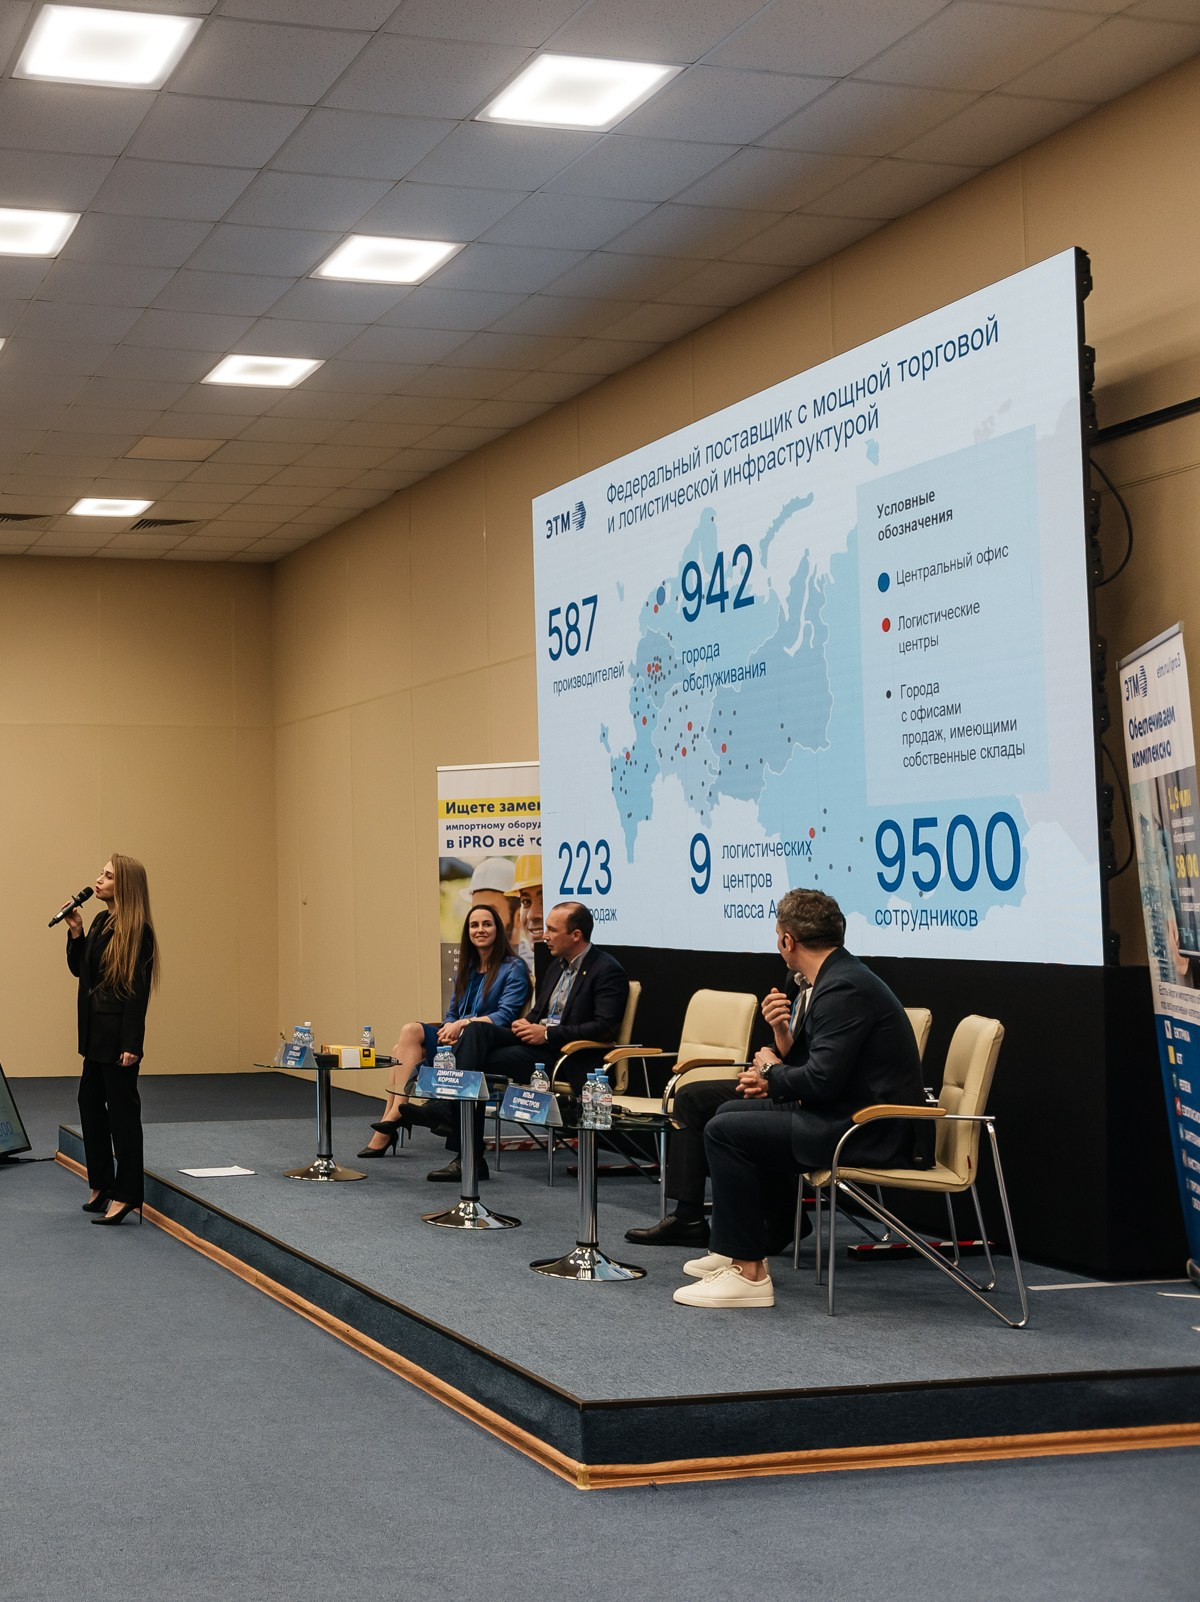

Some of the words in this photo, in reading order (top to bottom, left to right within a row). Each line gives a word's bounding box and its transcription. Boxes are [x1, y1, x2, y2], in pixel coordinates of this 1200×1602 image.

[606, 446, 701, 504] Федеральный
[705, 409, 793, 466] поставщик
[797, 404, 808, 424] с
[813, 362, 891, 419] мощной
[898, 313, 999, 382] торговой
[607, 515, 615, 534] и
[618, 470, 719, 530] логистической
[723, 403, 880, 487] инфраструктурой
[876, 489, 936, 519] Условные
[545, 511, 571, 539] ЭТМ
[877, 508, 954, 541] обозначения
[896, 552, 973, 587] Центральный
[976, 543, 1009, 566] офис
[681, 543, 755, 622] 942
[548, 594, 598, 661] 587
[897, 601, 981, 631] Логистические
[682, 643, 720, 667] города
[899, 634, 939, 654] центры
[553, 661, 625, 695] производителей
[682, 661, 767, 692] обслуживания
[900, 680, 940, 701] Города
[1124, 673, 1140, 701] ЭТМ
[901, 709, 907, 722] с
[910, 701, 962, 723] офисами
[1128, 705, 1176, 740] Обеспечиваем
[902, 727, 947, 747] продаж,
[950, 717, 1018, 740] имеющими
[902, 746, 977, 768] собственные
[980, 741, 1026, 760] склады
[1131, 739, 1172, 769] комплексно
[445, 801, 495, 815] Ищете
[445, 822, 505, 832] импортному
[446, 839, 454, 848] в
[458, 835, 495, 848] iPRO
[499, 835, 525, 847] всё
[689, 832, 712, 895] 9
[722, 840, 813, 859] логистических
[875, 811, 1021, 892] 9500
[558, 839, 612, 895] 223
[723, 872, 773, 893] центров
[723, 904, 764, 919] класса
[874, 909, 978, 932] сотрудников
[436, 1069, 464, 1077] ДМИТРИЙ
